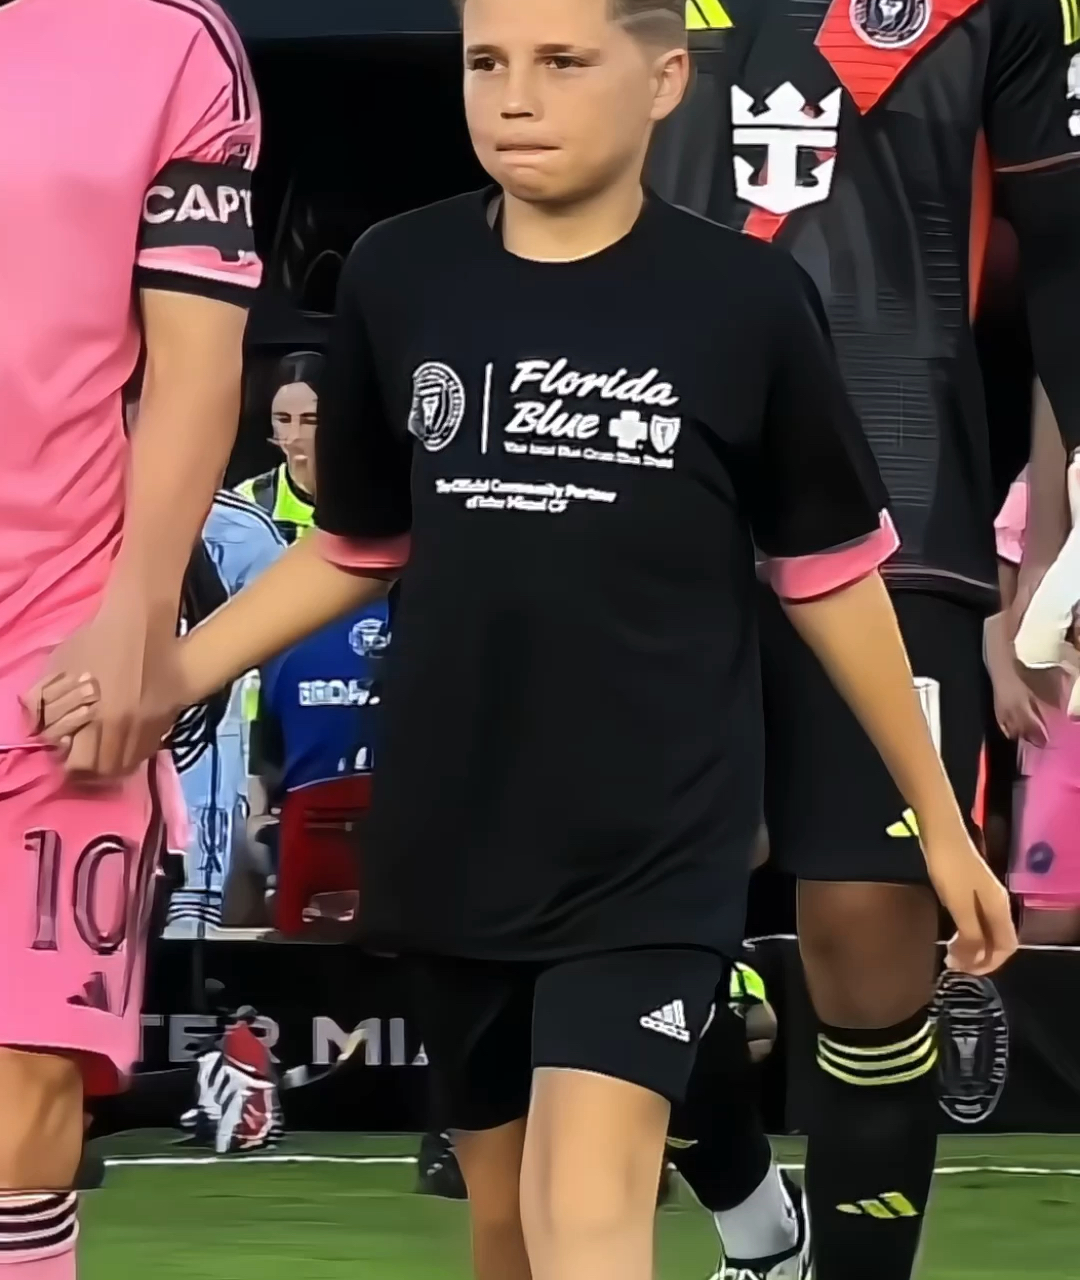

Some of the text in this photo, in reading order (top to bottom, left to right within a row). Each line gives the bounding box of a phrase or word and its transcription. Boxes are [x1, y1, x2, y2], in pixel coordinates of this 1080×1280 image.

[510, 357, 679, 406] Florida
[504, 399, 600, 439] Blue
[24, 829, 134, 956] 10
[312, 1016, 429, 1066] MI
